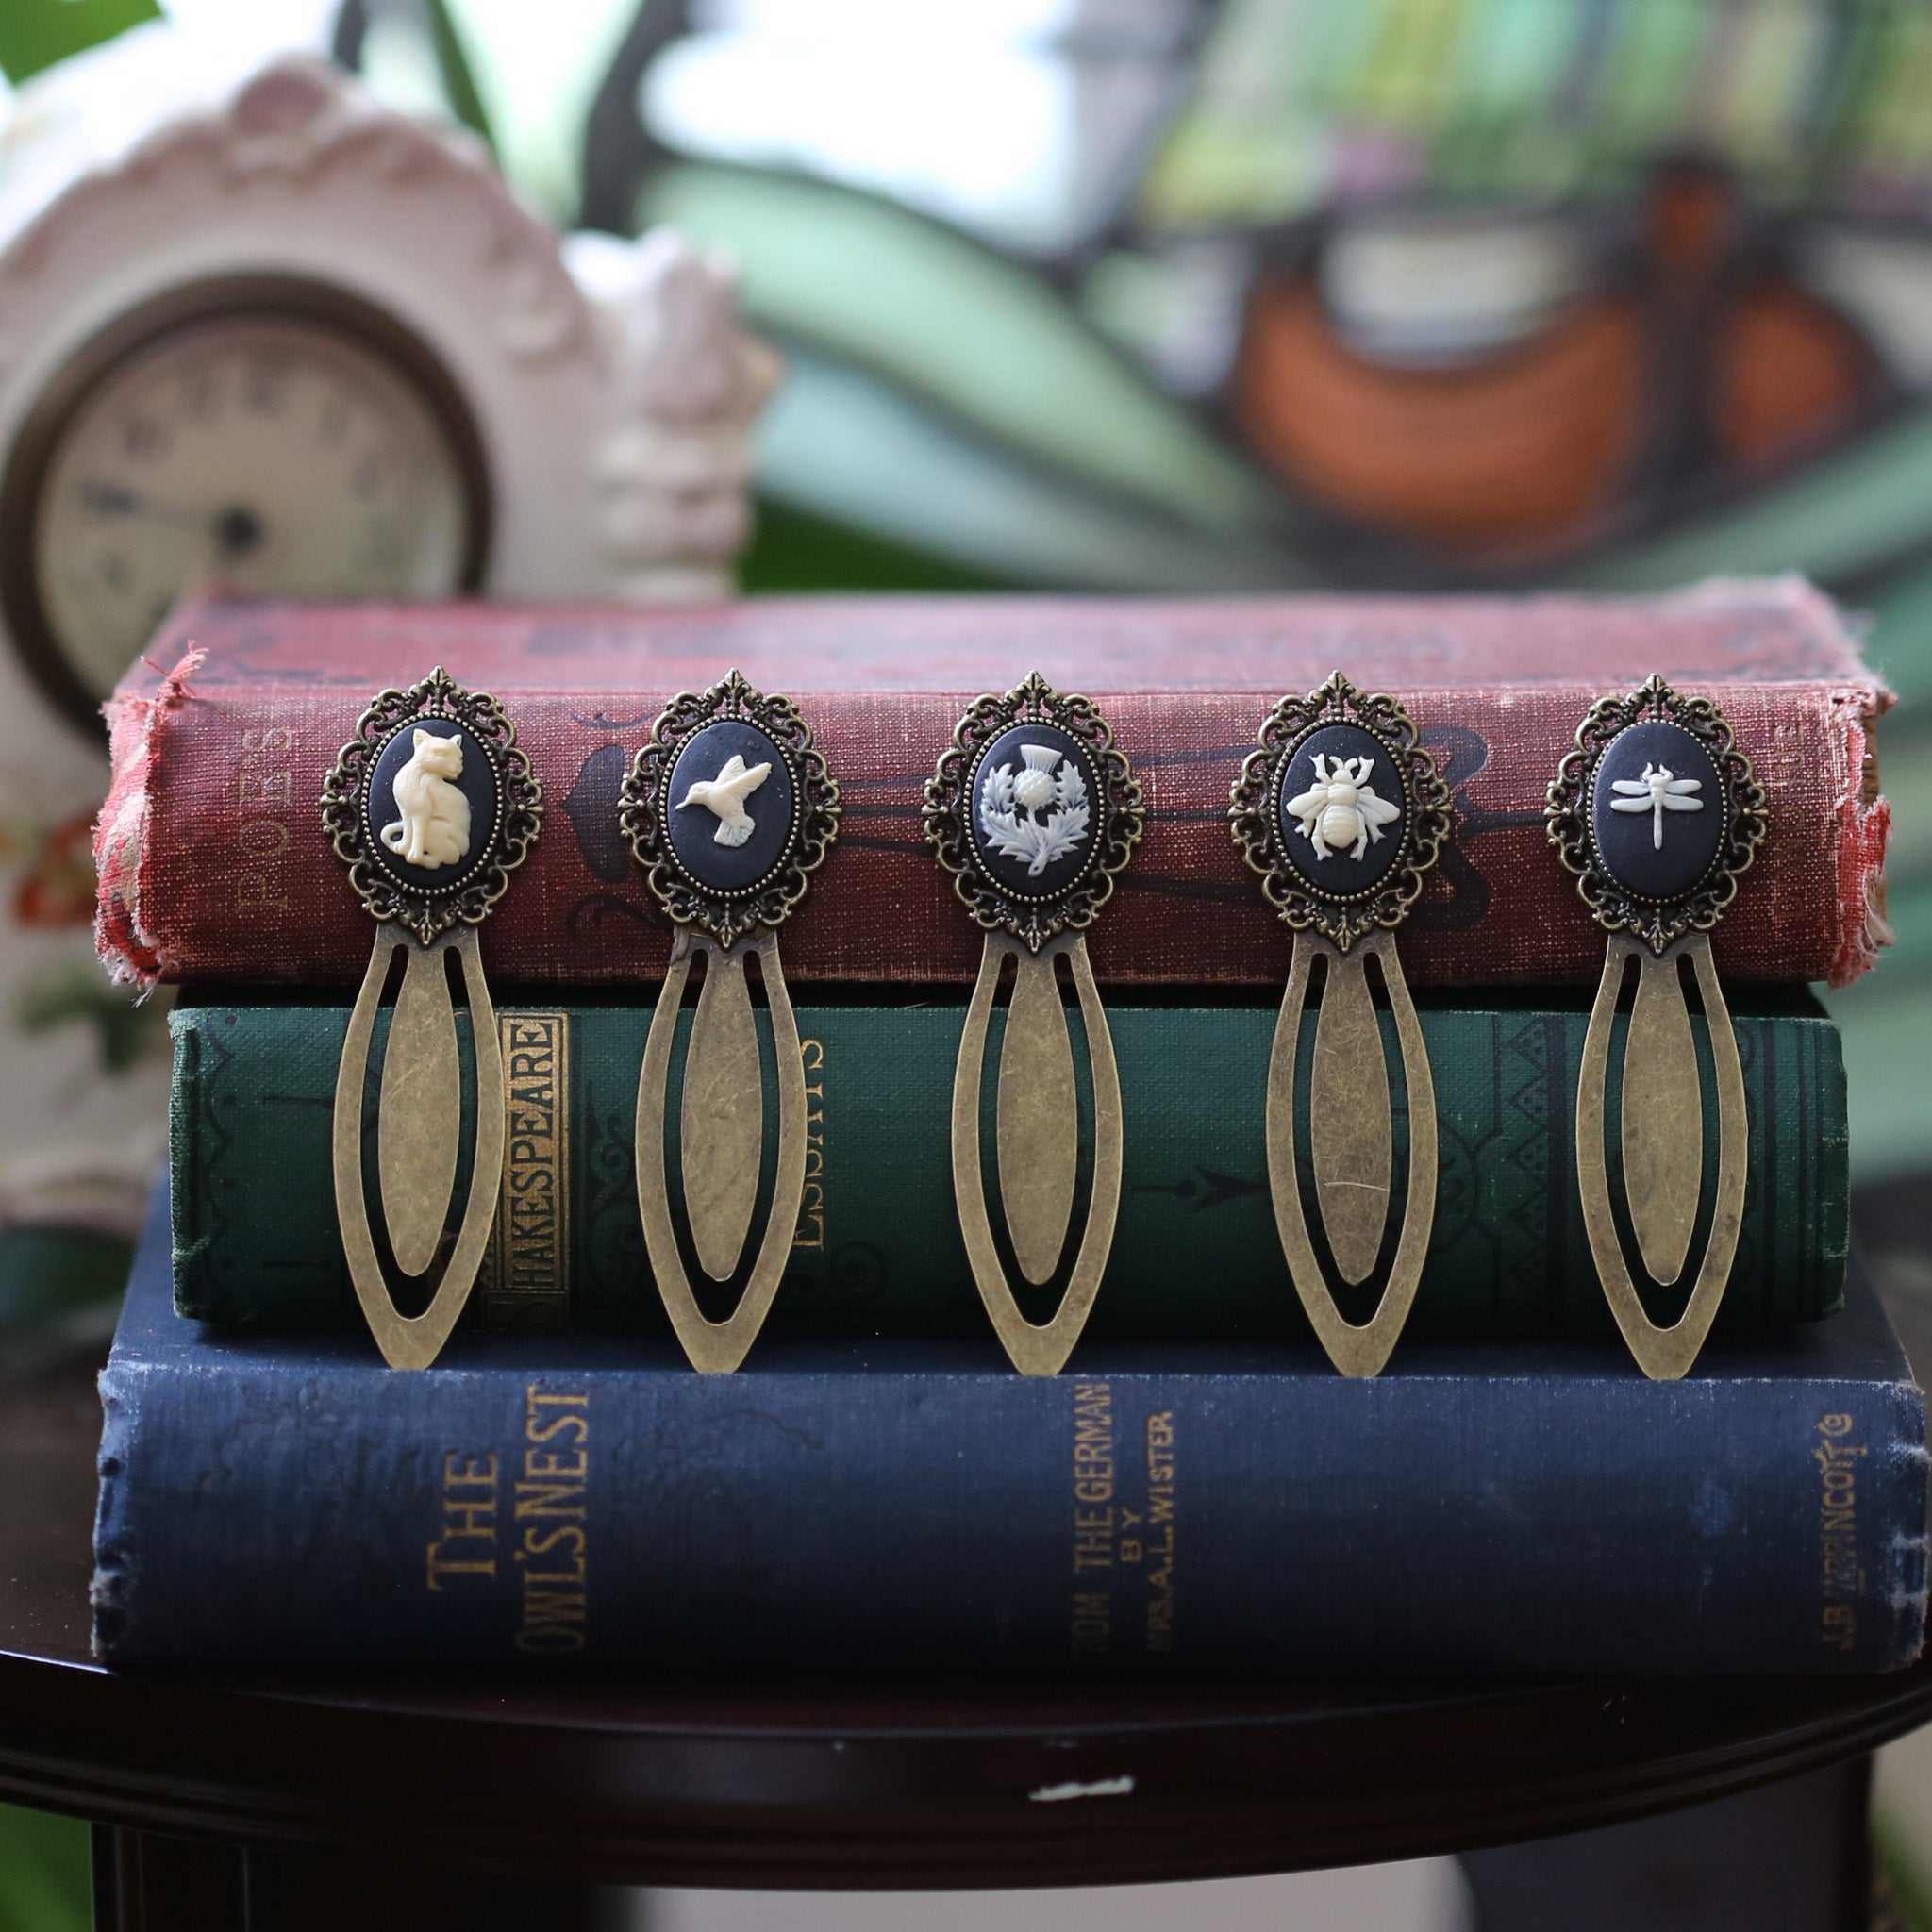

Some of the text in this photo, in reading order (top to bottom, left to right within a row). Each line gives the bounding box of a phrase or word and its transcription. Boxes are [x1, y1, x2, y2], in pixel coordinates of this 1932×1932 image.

[497, 1023, 556, 1327] SHAKESPEARE
[514, 1385, 589, 1521] NEST
[1074, 1382, 1113, 1502] GERMAN
[1074, 1507, 1113, 1573] THE
[1120, 1507, 1142, 1563] BY
